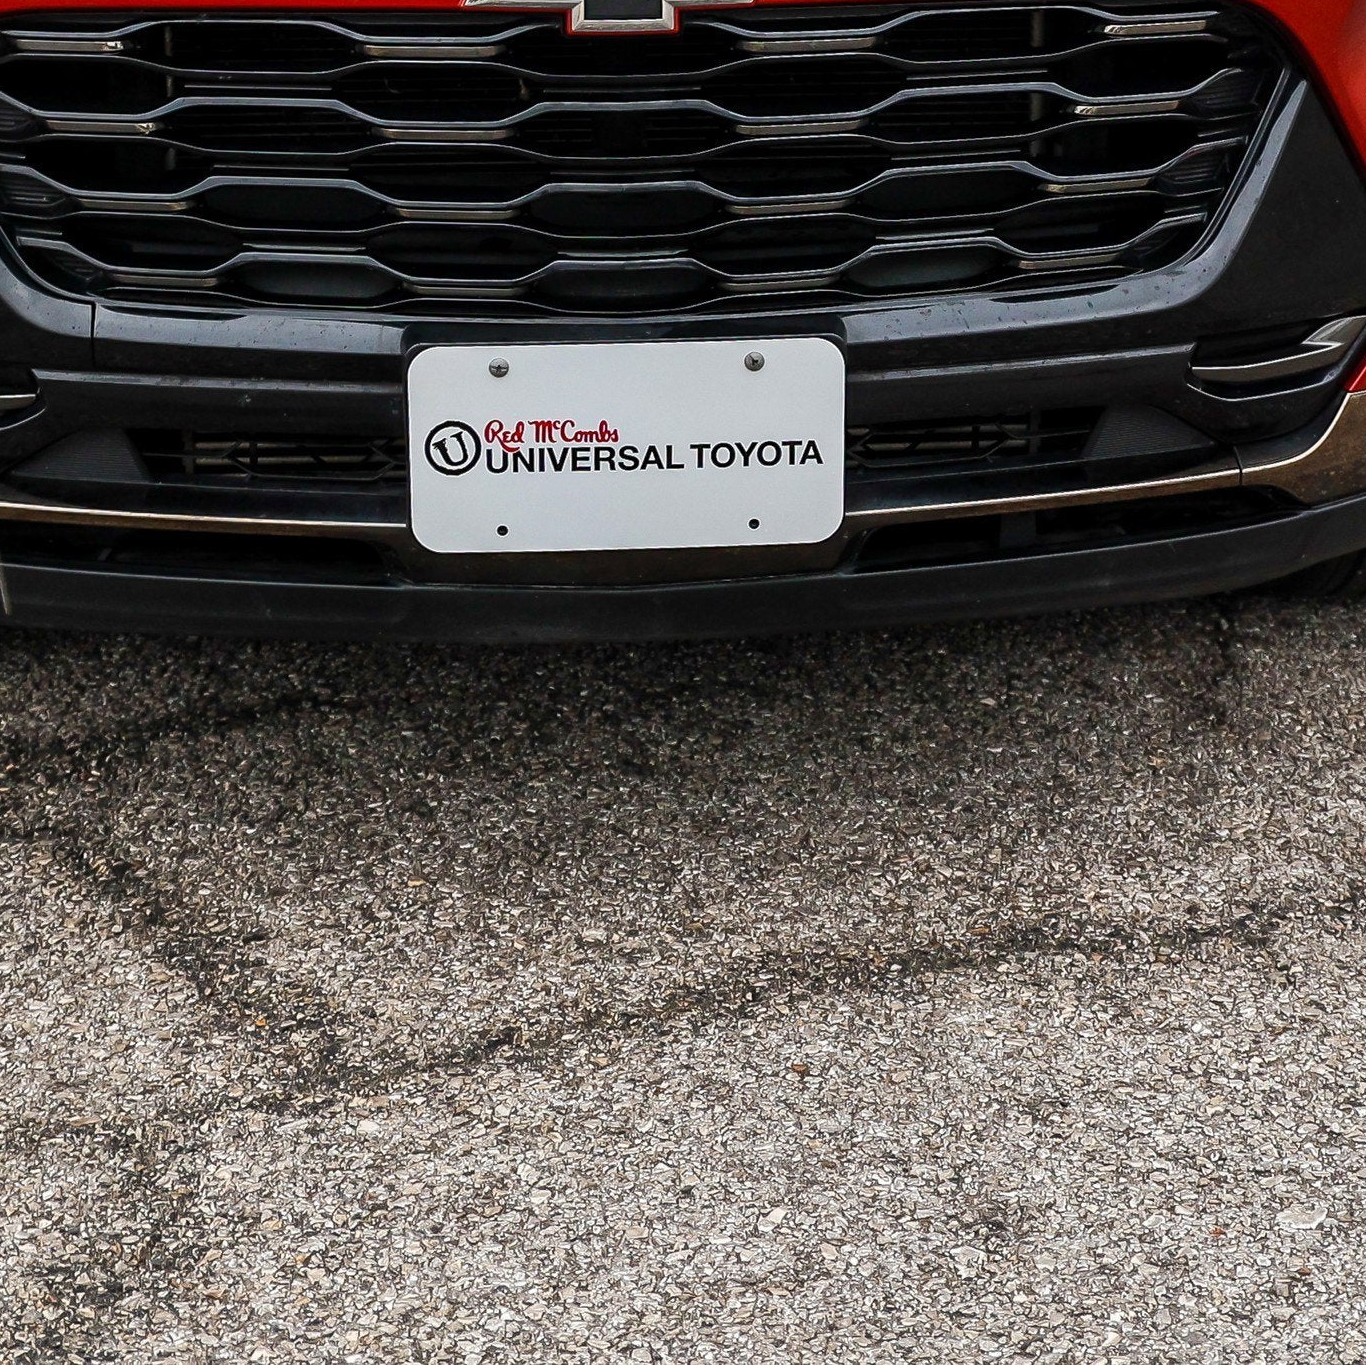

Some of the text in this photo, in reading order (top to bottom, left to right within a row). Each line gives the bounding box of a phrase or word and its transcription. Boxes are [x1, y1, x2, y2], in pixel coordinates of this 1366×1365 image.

[484, 419, 619, 453] Red McCombs
[485, 439, 824, 474] UNIVERSAL TOYOTA
